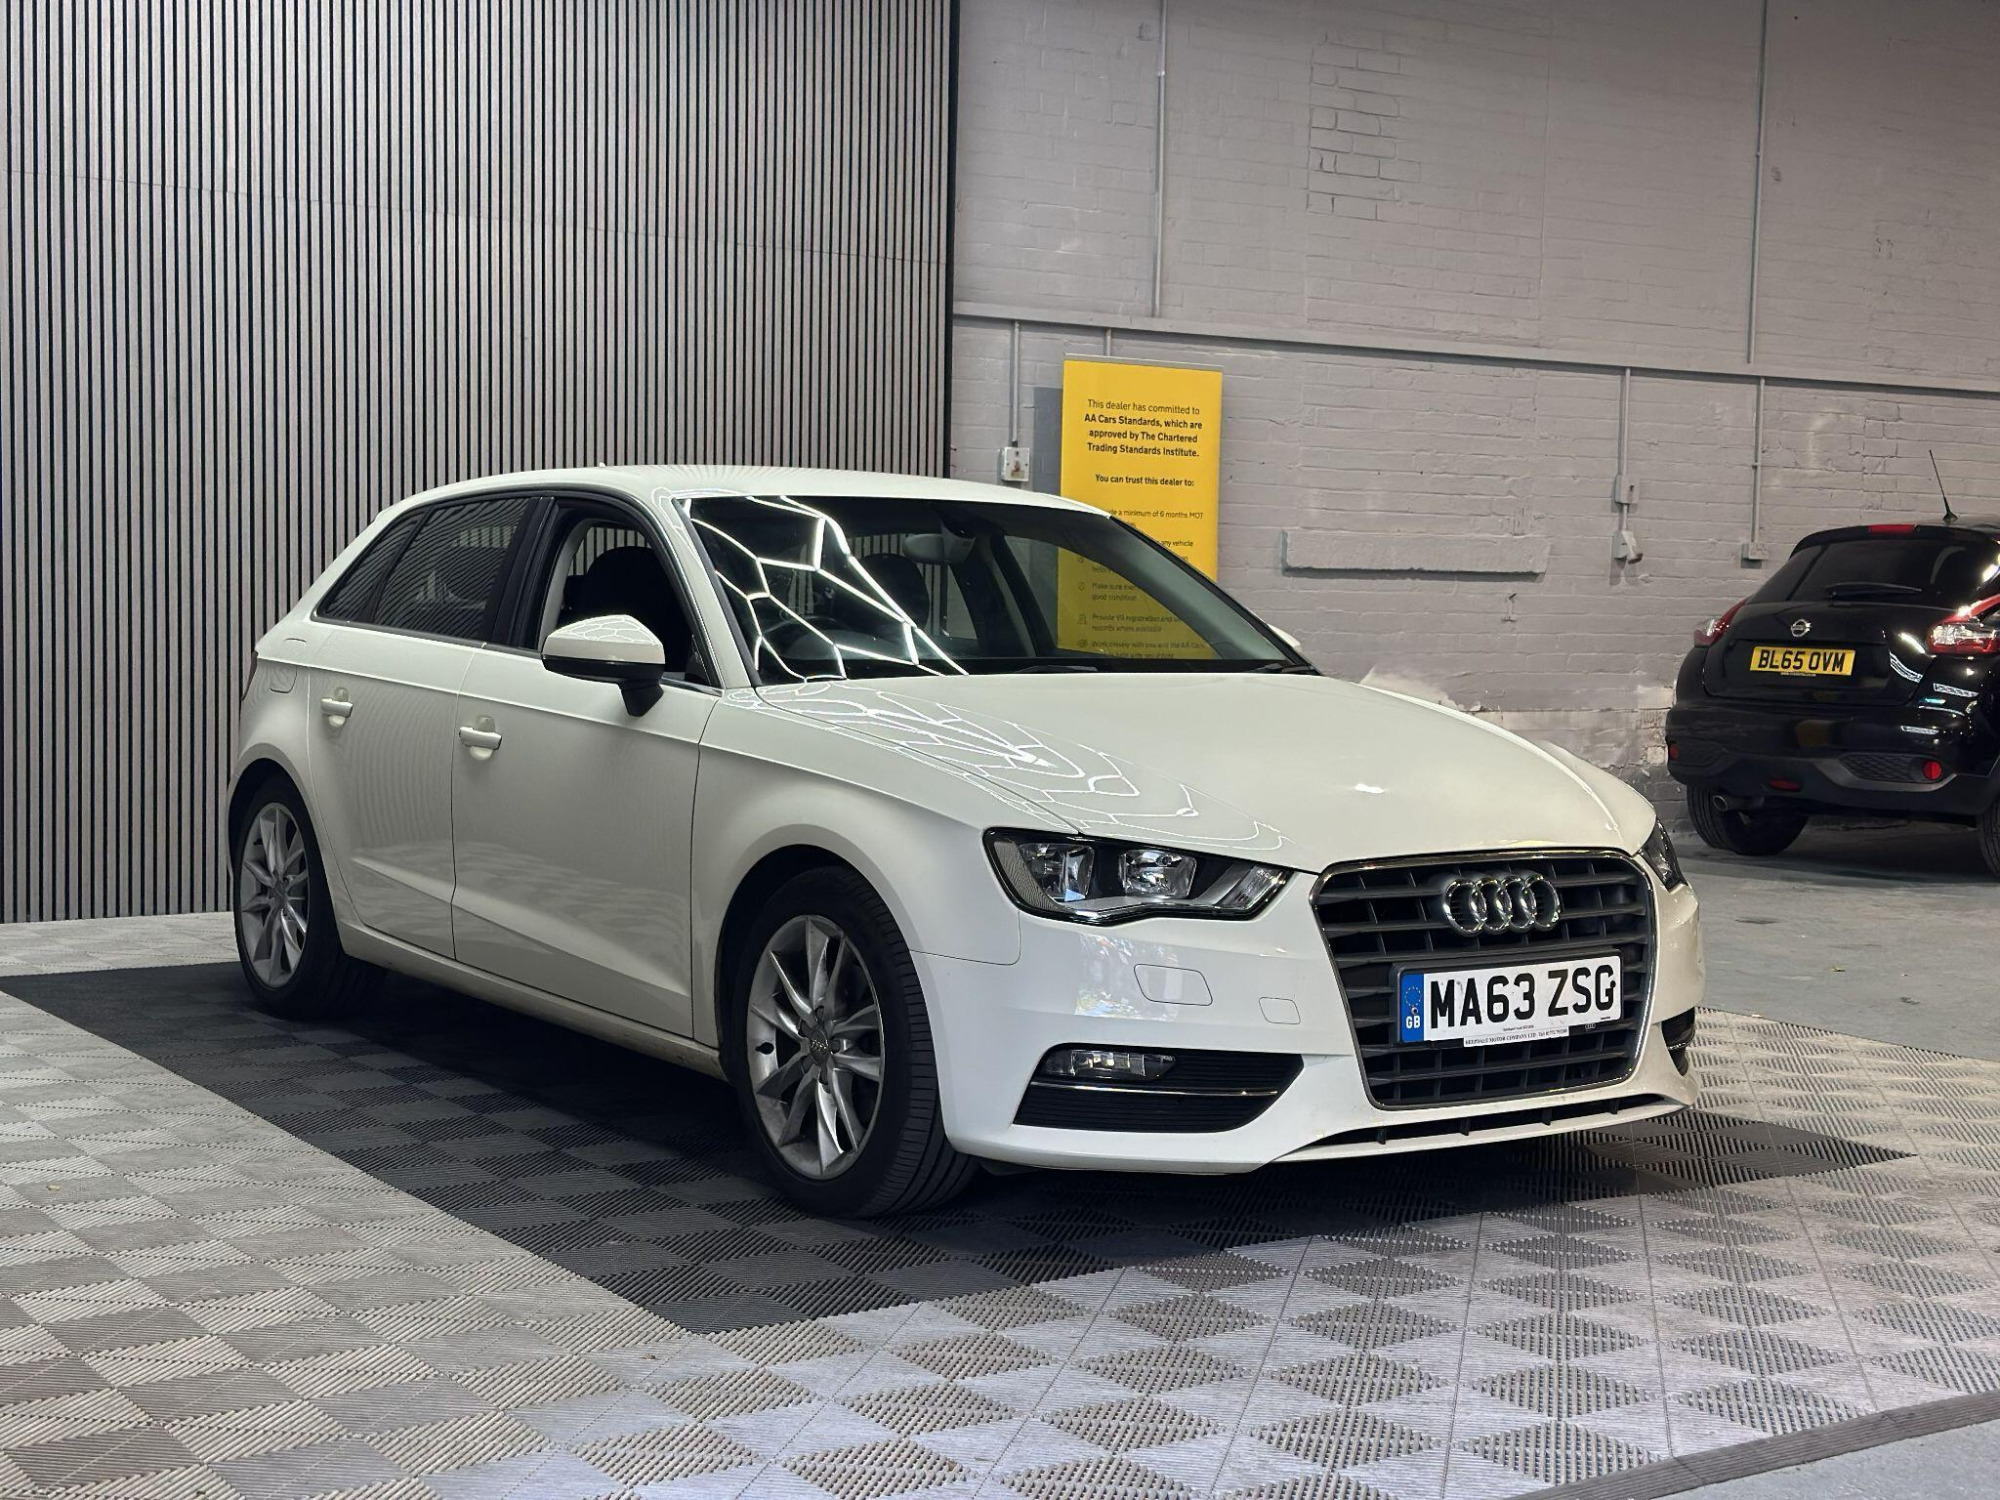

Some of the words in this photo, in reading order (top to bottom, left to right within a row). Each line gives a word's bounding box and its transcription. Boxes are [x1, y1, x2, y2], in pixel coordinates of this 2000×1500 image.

[1088, 399, 1104, 409] This
[1106, 401, 1131, 410] dealer
[1133, 403, 1146, 411] has
[1148, 404, 1190, 414] committed
[1192, 407, 1200, 415] to
[1084, 414, 1096, 422] AA
[1098, 415, 1117, 424] Cars
[1118, 416, 1162, 427] Standards,
[1164, 419, 1188, 428] which
[1089, 430, 1127, 439] approved
[1129, 431, 1139, 441] by
[1140, 431, 1155, 440] The
[1157, 433, 1197, 443] Chartered
[1087, 443, 1117, 454] Trading
[1119, 445, 1161, 455] Standards
[1163, 448, 1199, 457] Institute.
[1095, 474, 1109, 483] You
[1125, 476, 1143, 484] trust
[1144, 477, 1158, 485] this
[1160, 478, 1182, 486] dealer
[1758, 650, 1805, 670] BL65
[1808, 651, 1845, 672] OVM
[1430, 972, 1535, 1029] MA63
[1548, 964, 1615, 1018] ZSG
[1405, 1015, 1421, 1029] GB
